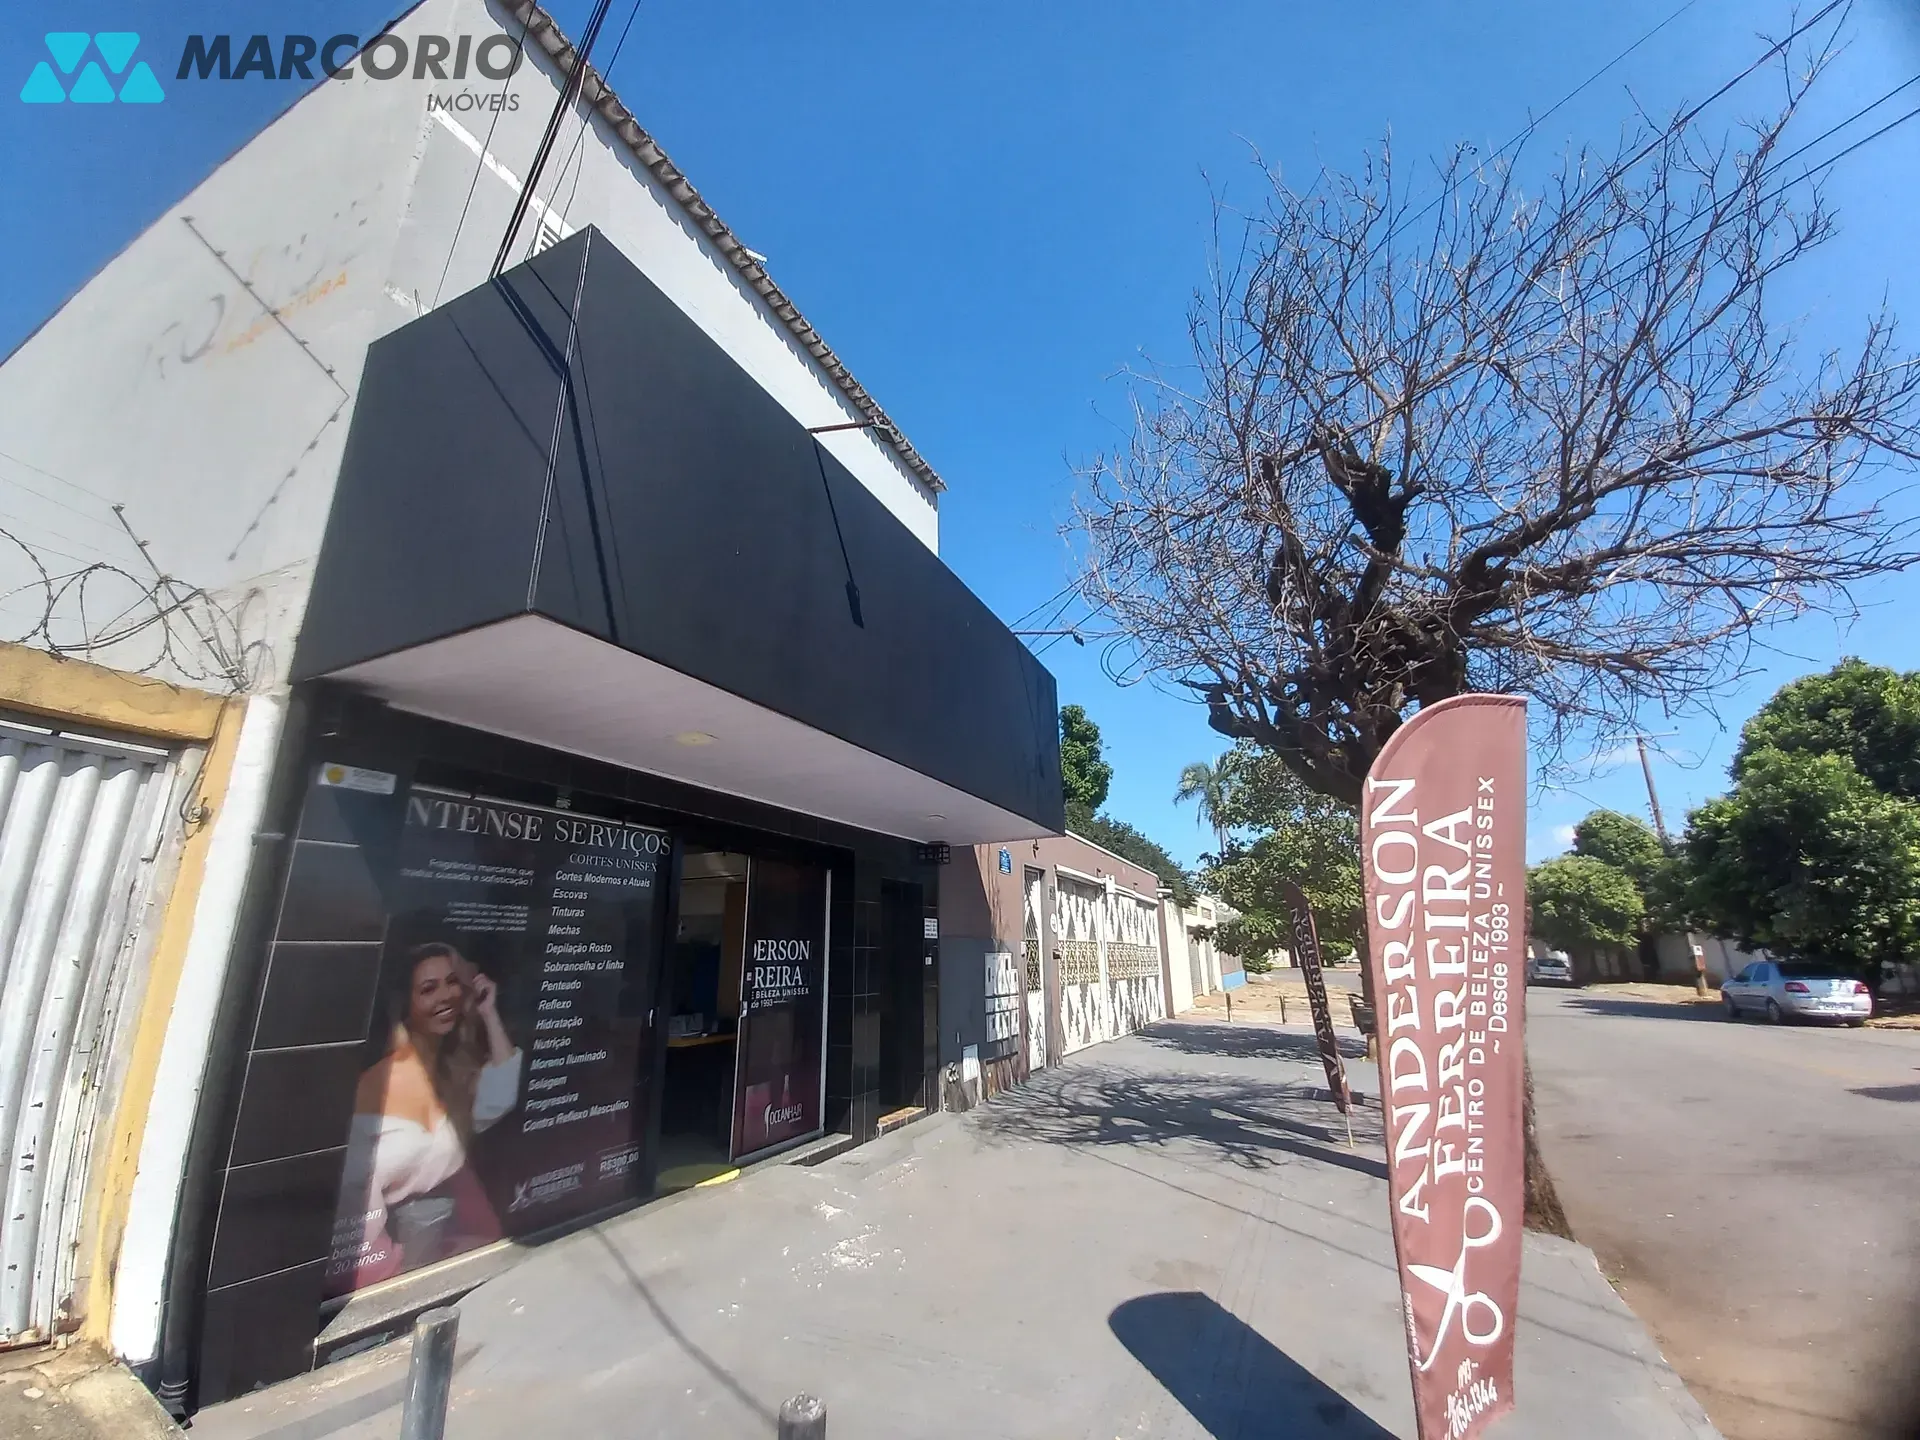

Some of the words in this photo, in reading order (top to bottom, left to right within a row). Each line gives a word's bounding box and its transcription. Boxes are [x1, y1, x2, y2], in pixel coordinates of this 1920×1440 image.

[554, 819, 672, 857] SERVIÇOS
[1474, 776, 1495, 899] UNISSEX
[569, 853, 615, 868] CORTES
[615, 856, 658, 873] UNISSEX
[555, 870, 583, 882] Cortes
[584, 873, 621, 886] Modernos
[628, 877, 651, 888] Atuais
[552, 888, 588, 900] Escovas
[551, 906, 585, 917] Tinturas
[547, 924, 581, 935] Mechas
[1491, 903, 1510, 953] 1993
[546, 942, 588, 955] Depilação
[588, 942, 612, 953] Rosto
[543, 960, 595, 973] Sobrancelha
[596, 960, 606, 970] c/
[605, 959, 625, 970] linha
[1470, 912, 1491, 1016] BELEZA
[541, 980, 582, 992] Penteado
[751, 965, 803, 989] REIRA
[755, 989, 781, 999] BELEZA
[782, 987, 809, 997] UNISSEX
[1368, 776, 1432, 1224] ANDERSON
[1434, 805, 1473, 1185] FERREIRA
[1488, 962, 1508, 1033] Desde
[538, 998, 572, 1010] Reflexo
[535, 1016, 583, 1030] Hidratação
[532, 1036, 571, 1051] Nutrição
[1469, 1030, 1486, 1065] DE
[530, 1056, 565, 1071] Moreno
[566, 1049, 607, 1065] Iluminado
[528, 1075, 568, 1092] Selagem
[525, 1092, 579, 1113] Progressiva
[555, 1109, 589, 1125] Reflexo
[588, 1100, 630, 1119] Masculino
[1467, 1078, 1484, 1193] CENTRO
